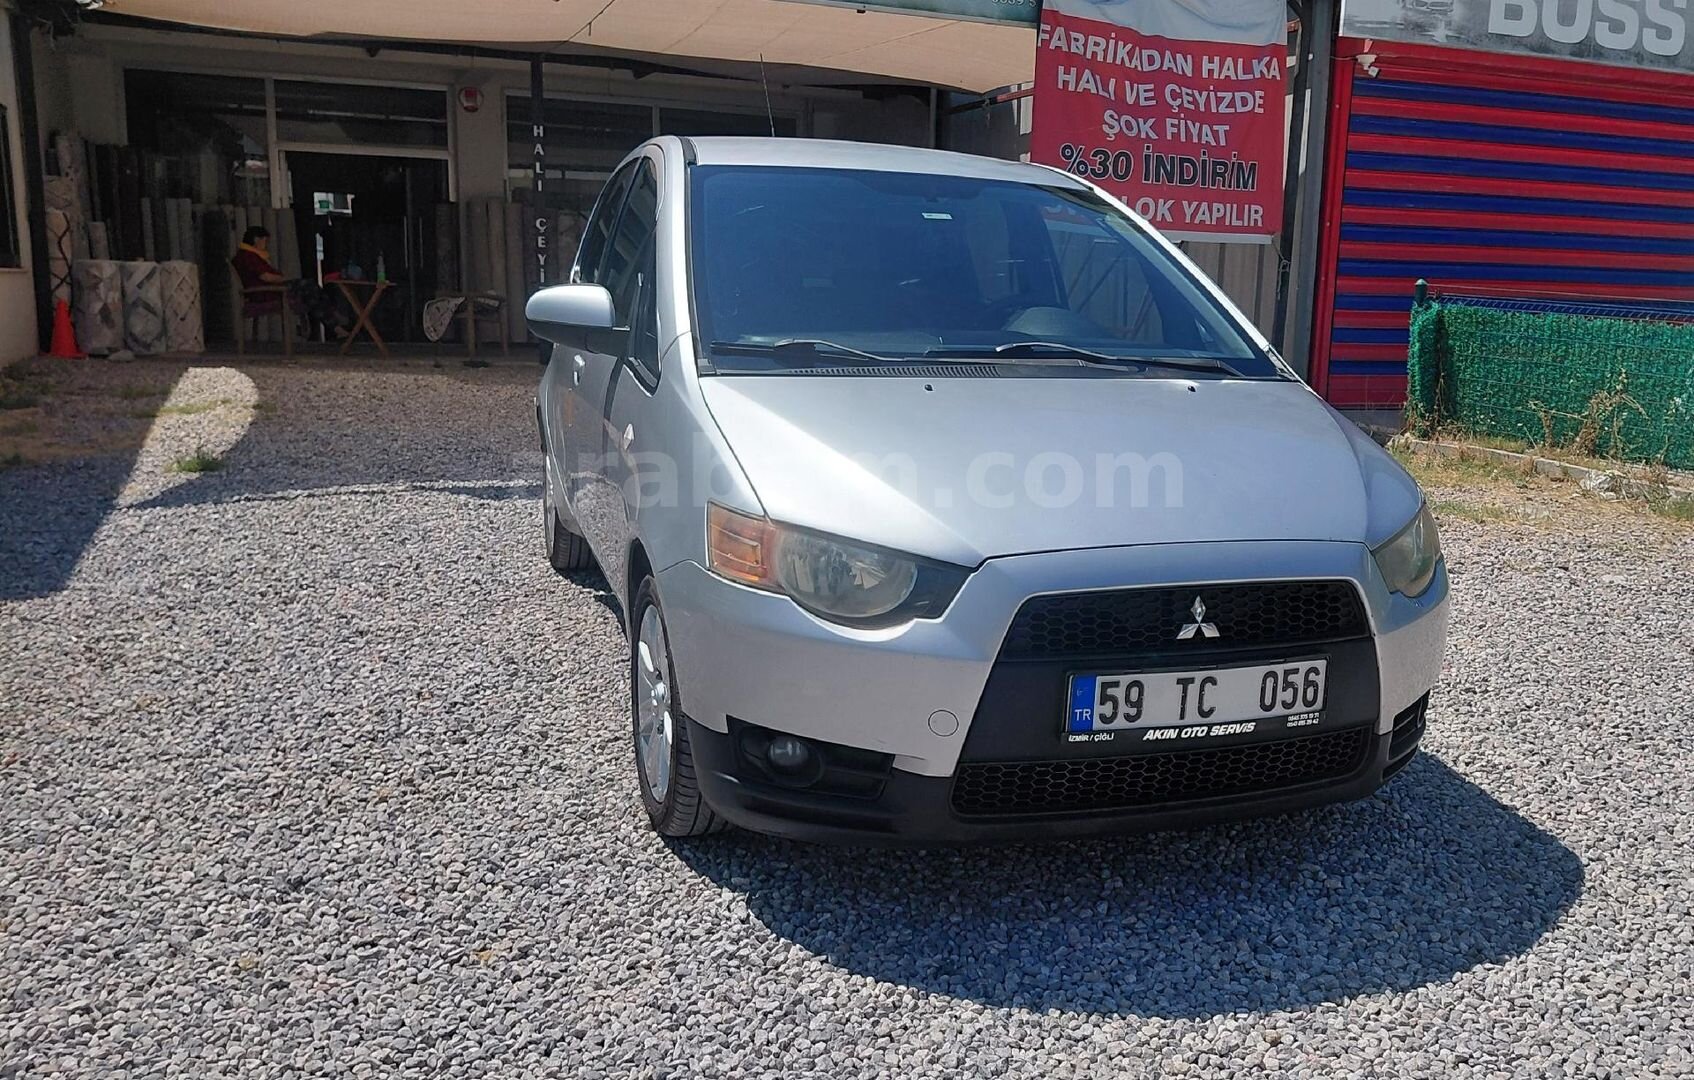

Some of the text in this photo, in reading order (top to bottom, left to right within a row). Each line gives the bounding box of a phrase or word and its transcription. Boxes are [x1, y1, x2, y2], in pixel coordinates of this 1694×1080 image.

[1037, 24, 1281, 81] FABRİKADAN HALKA
[1057, 66, 1265, 114] HALI VE ÇEYİZDE
[1102, 110, 1230, 147] ŞOK FİYAT
[533, 125, 544, 191] HALI
[1060, 143, 1258, 192] %30 İNDİRİM
[1182, 201, 1263, 228] YAPILIR
[535, 218, 547, 288] ÇEYİ
[1074, 708, 1092, 723] TR
[1099, 666, 1321, 725] 59 TC 056
[1142, 728, 1180, 741] AKIN
[1180, 726, 1209, 739] OTO
